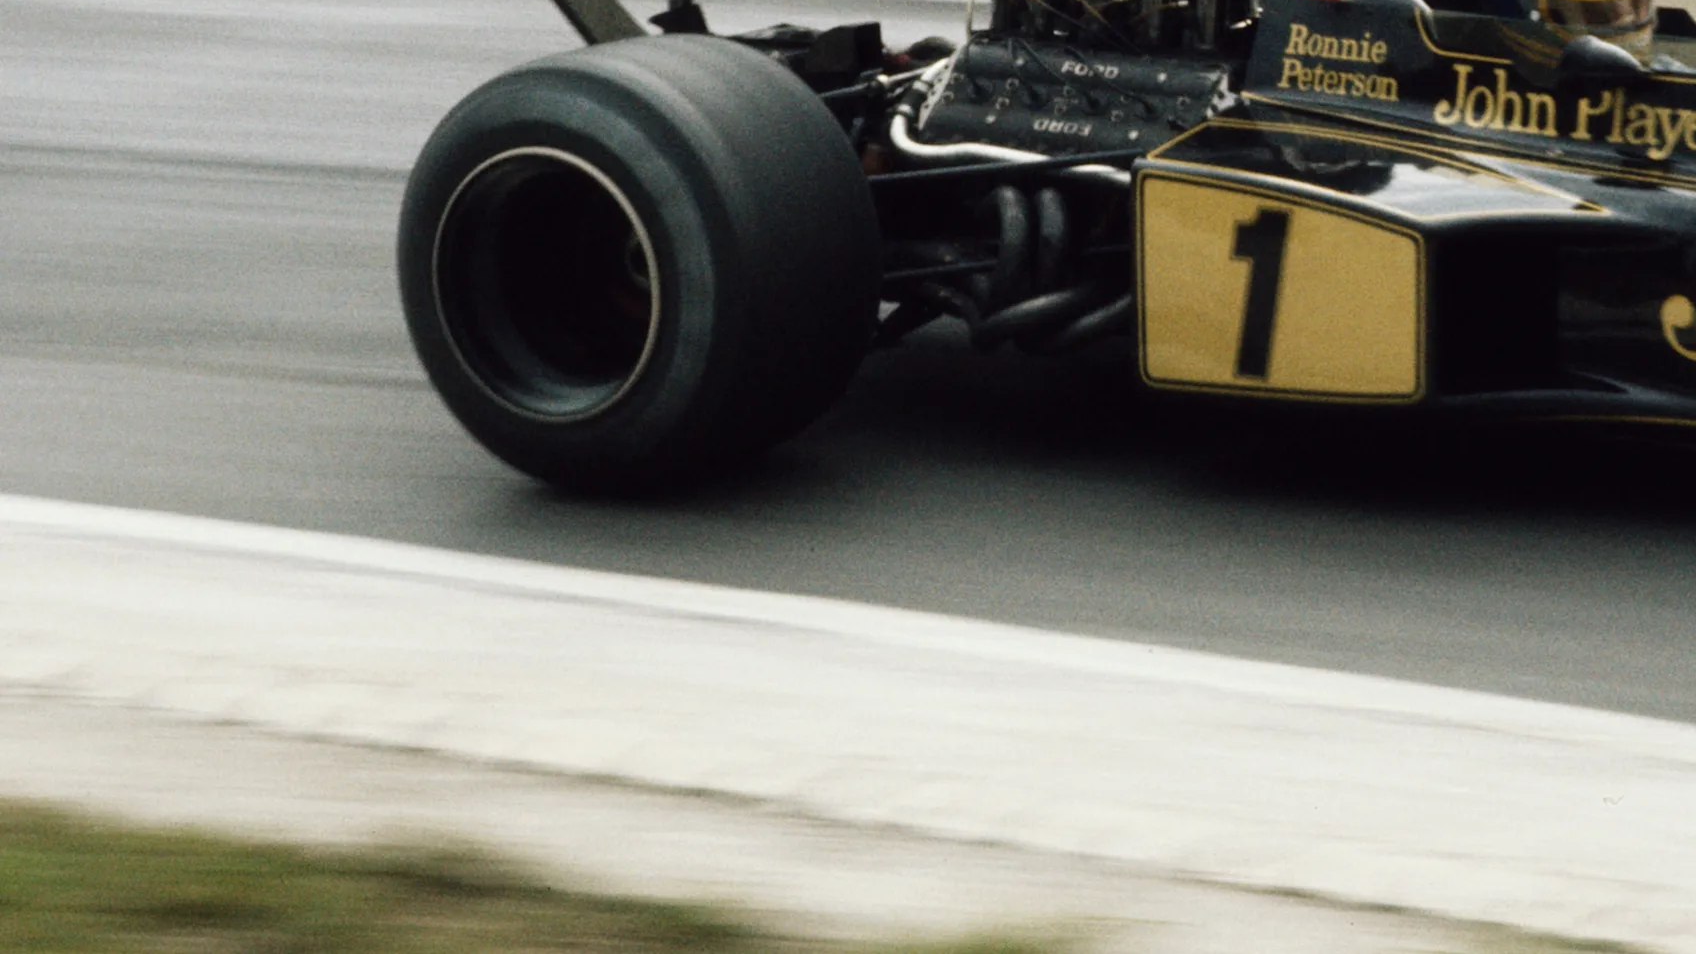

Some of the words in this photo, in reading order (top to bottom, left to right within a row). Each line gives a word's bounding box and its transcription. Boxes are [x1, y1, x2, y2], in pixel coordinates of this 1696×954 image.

[1285, 23, 1388, 64] Ronnie
[1277, 57, 1399, 102] Peterson
[1433, 64, 1558, 138] John
[1230, 206, 1293, 381] 1
